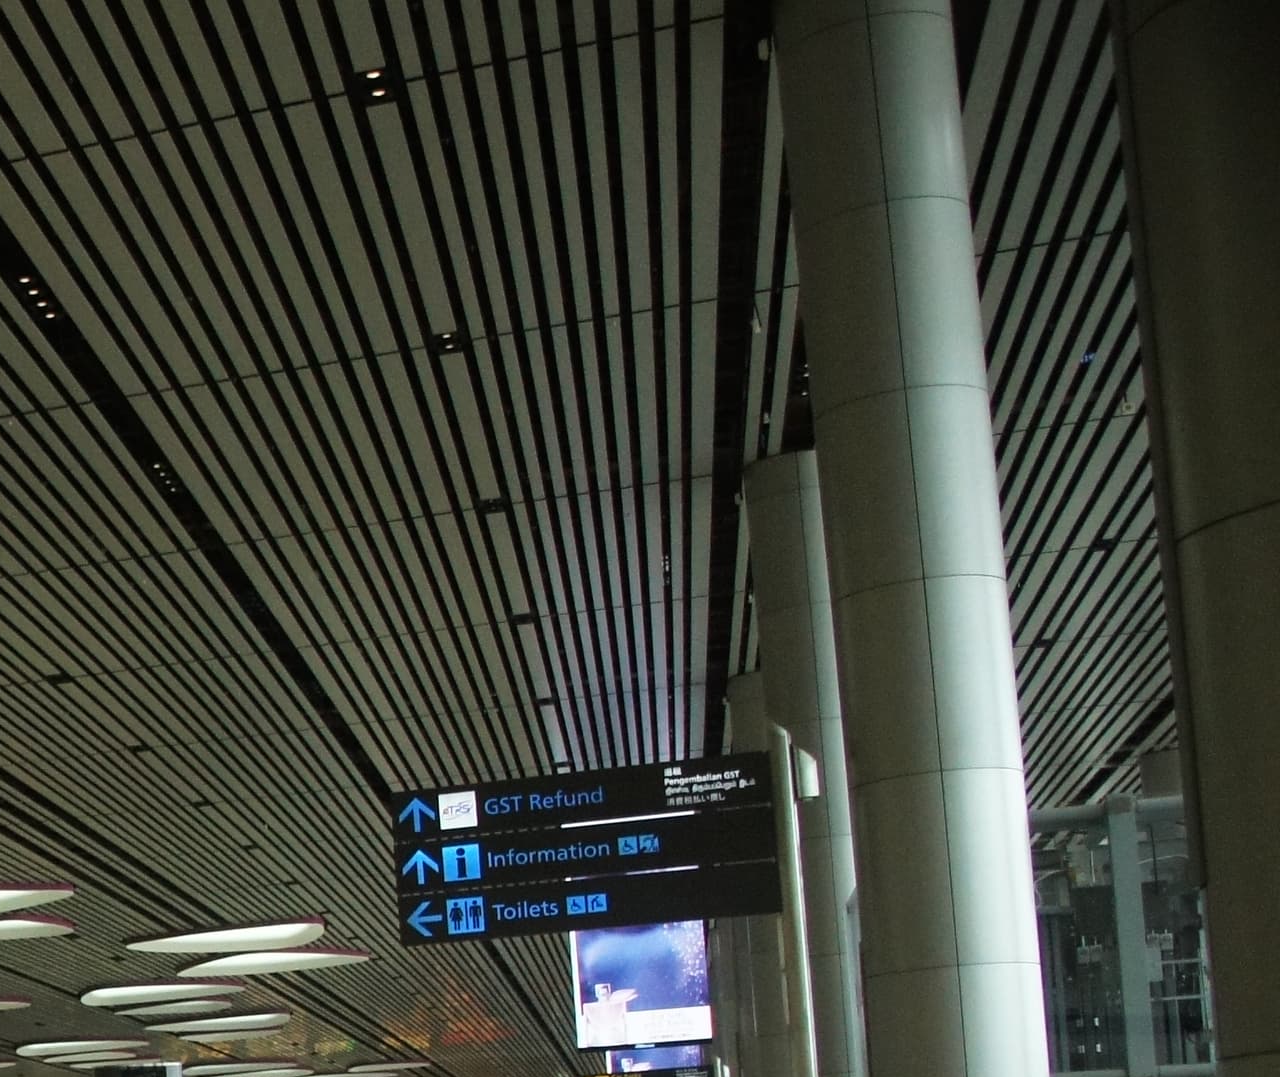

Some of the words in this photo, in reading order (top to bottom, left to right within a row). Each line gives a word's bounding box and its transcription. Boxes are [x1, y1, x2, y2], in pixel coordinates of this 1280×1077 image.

[664, 772, 722, 787] Pengembalian
[724, 769, 740, 780] GST
[484, 795, 523, 816] GST
[529, 786, 605, 811] Refund
[487, 841, 611, 869] Information
[492, 900, 560, 921] Toilets
